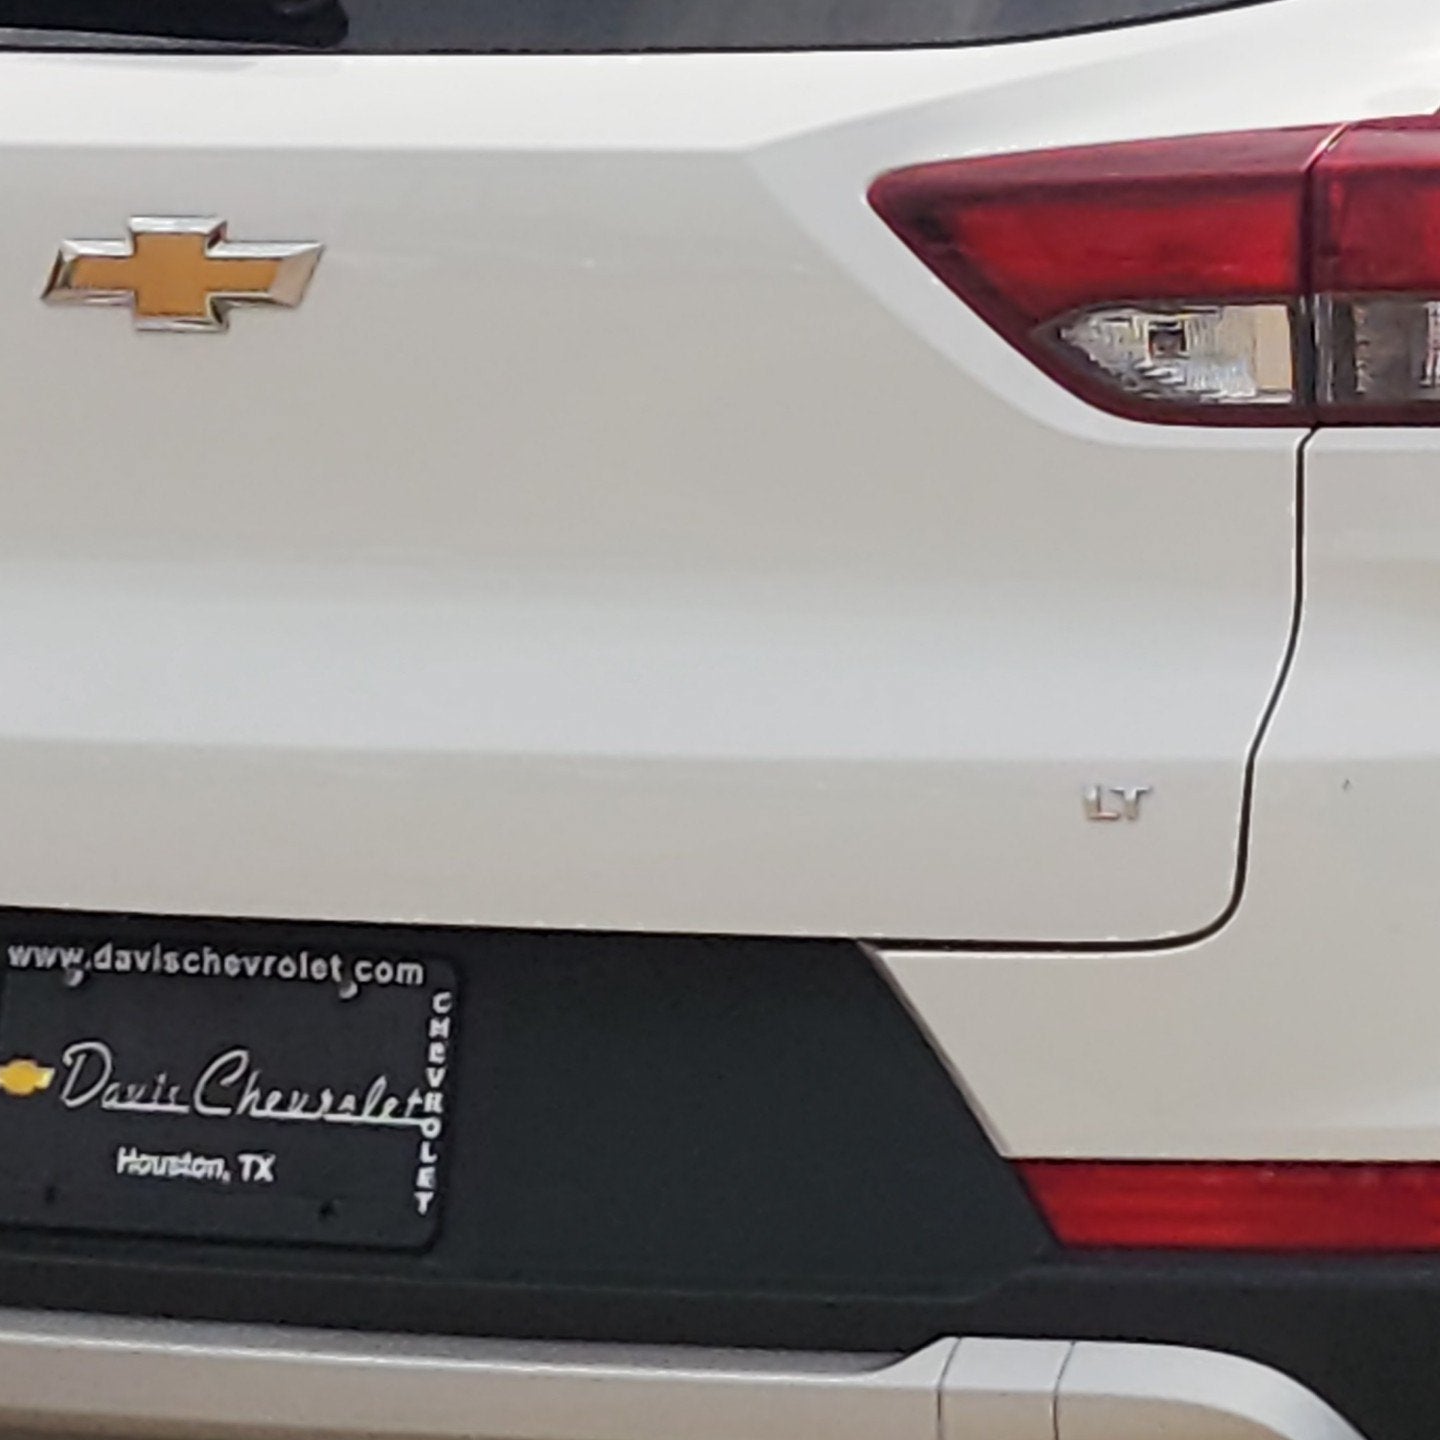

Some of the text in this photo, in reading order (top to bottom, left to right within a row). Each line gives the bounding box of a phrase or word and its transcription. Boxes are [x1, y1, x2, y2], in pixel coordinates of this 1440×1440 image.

[1082, 784, 1153, 822] LT
[7, 942, 425, 987] www.davischevroletcom
[62, 1040, 422, 1126] Davis Chevrolet
[238, 1153, 277, 1184] TX
